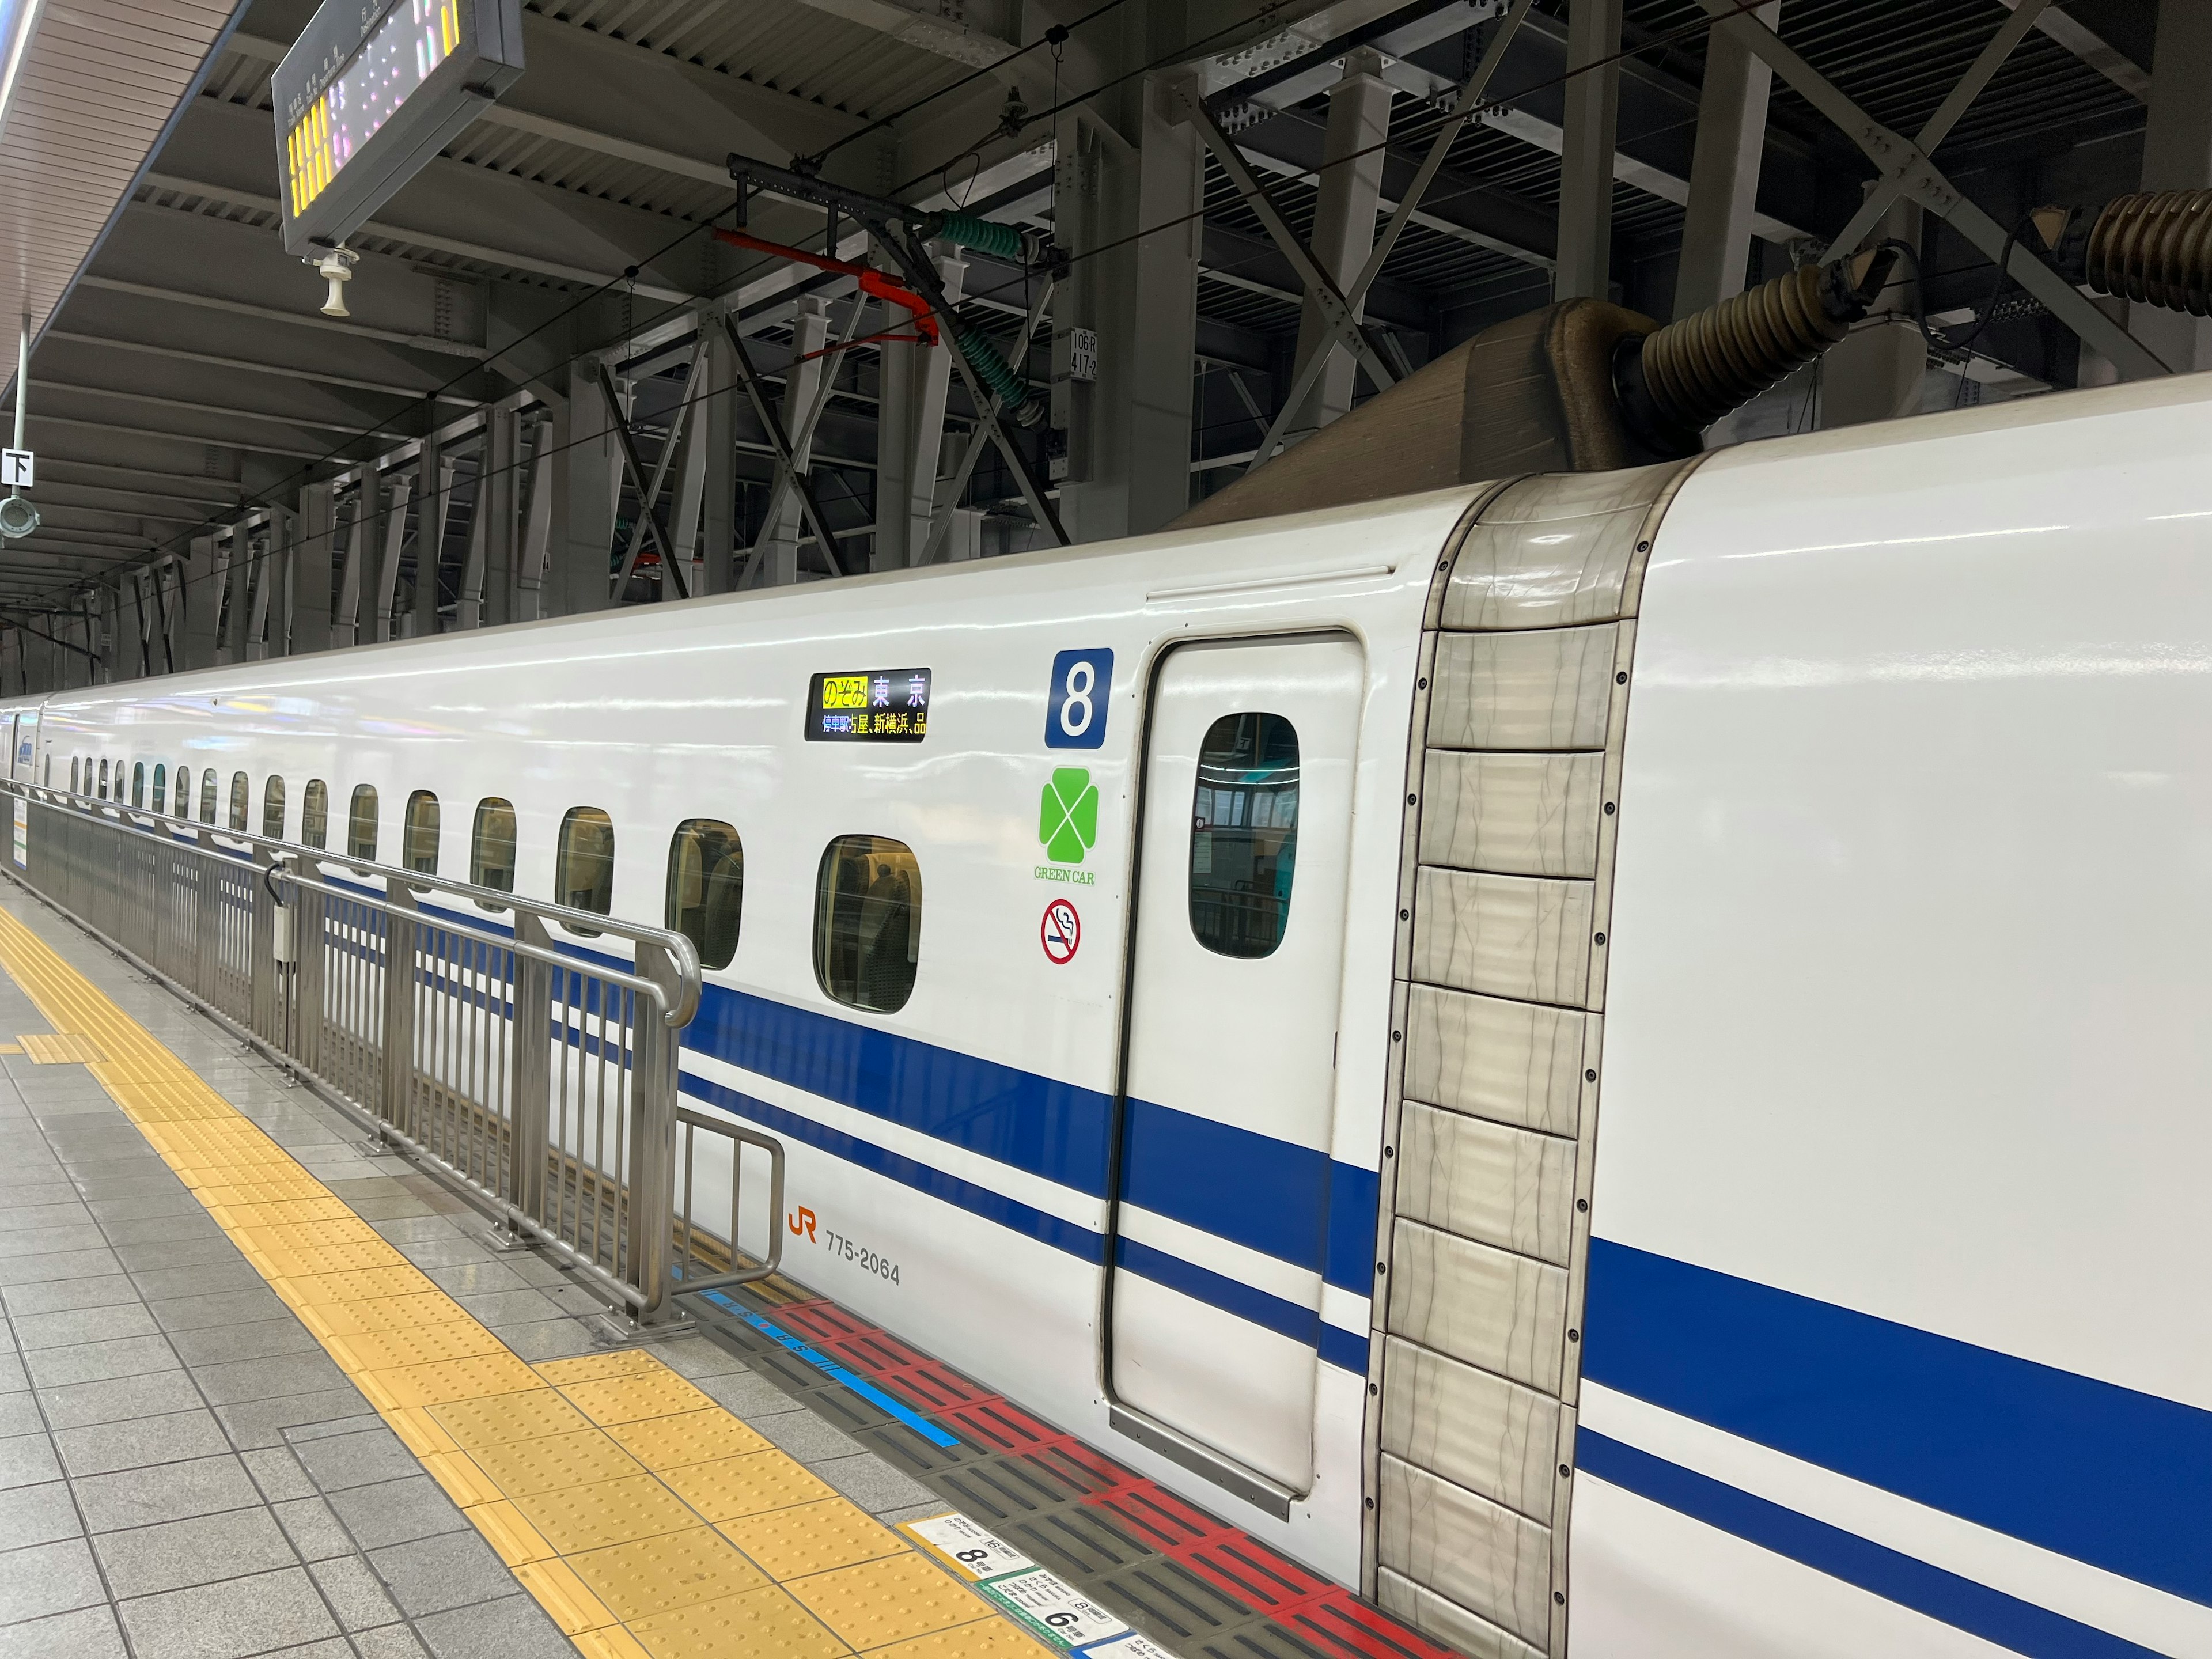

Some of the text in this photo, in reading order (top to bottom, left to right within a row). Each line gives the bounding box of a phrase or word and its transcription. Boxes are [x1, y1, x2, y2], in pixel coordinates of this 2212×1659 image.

[1071, 352, 1096, 376] 417-2
[5, 452, 30, 483] 下
[824, 679, 866, 707] のぞみ
[1060, 661, 1095, 737] 8
[1034, 866, 1095, 885] GREEN CAR
[788, 1205, 817, 1244] JR
[825, 1229, 900, 1286] 775-2064
[945, 1520, 961, 1530] ひかり
[984, 1540, 1000, 1548] 16
[956, 1549, 988, 1562] 8
[976, 1561, 993, 1572] 号車
[1009, 1582, 1026, 1594] つばめ
[1019, 1579, 1037, 1592] ひかり
[1029, 1577, 1060, 1600] さくら SAKURA
[1039, 1573, 1058, 1585] みずほ
[998, 1585, 1017, 1596] こだま
[1045, 1612, 1085, 1638] 6 号車
[1125, 1643, 1145, 1657] つばめ
[1135, 1639, 1157, 1654] さくら
